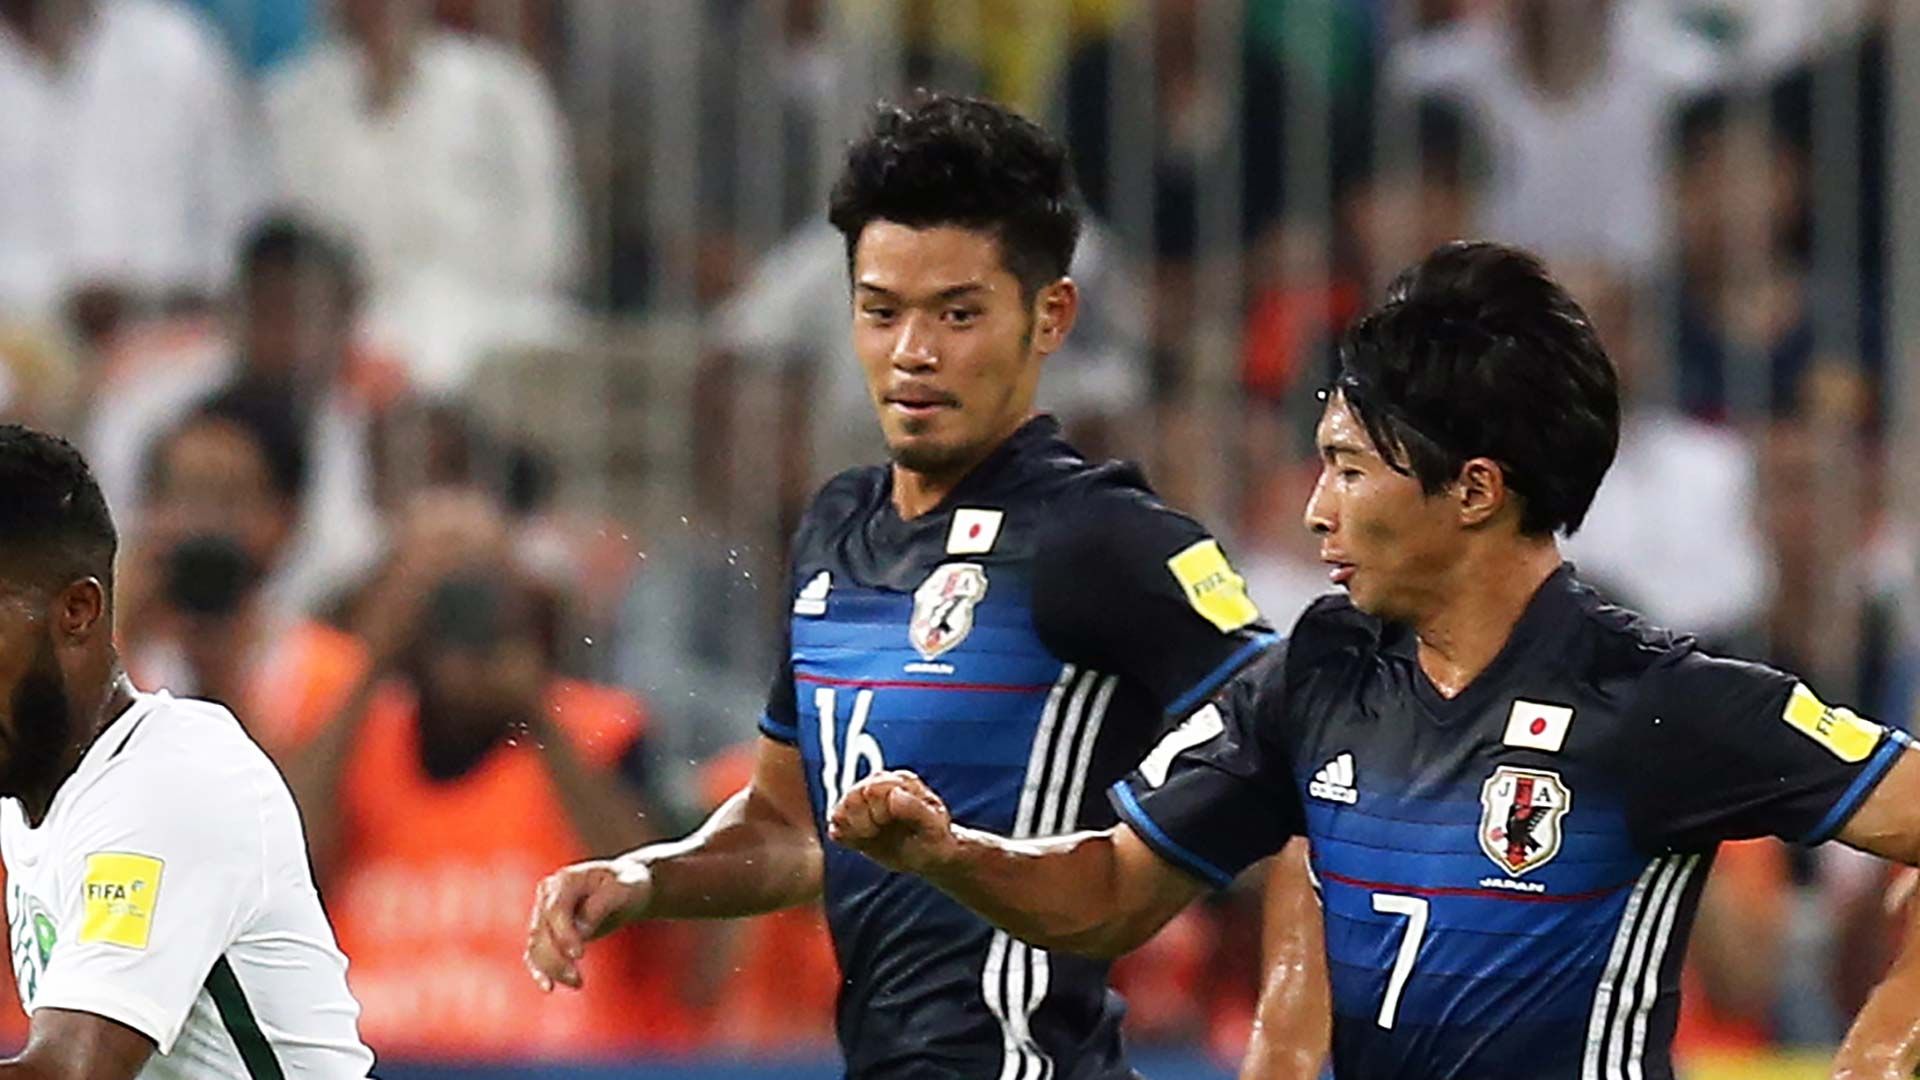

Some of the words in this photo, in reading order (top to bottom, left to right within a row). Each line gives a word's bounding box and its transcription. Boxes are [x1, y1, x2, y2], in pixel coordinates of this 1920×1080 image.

[814, 688, 885, 822] 16
[88, 884, 126, 899] FIFA
[1479, 877, 1545, 893] JAPAN
[1372, 892, 1429, 1030] 7
